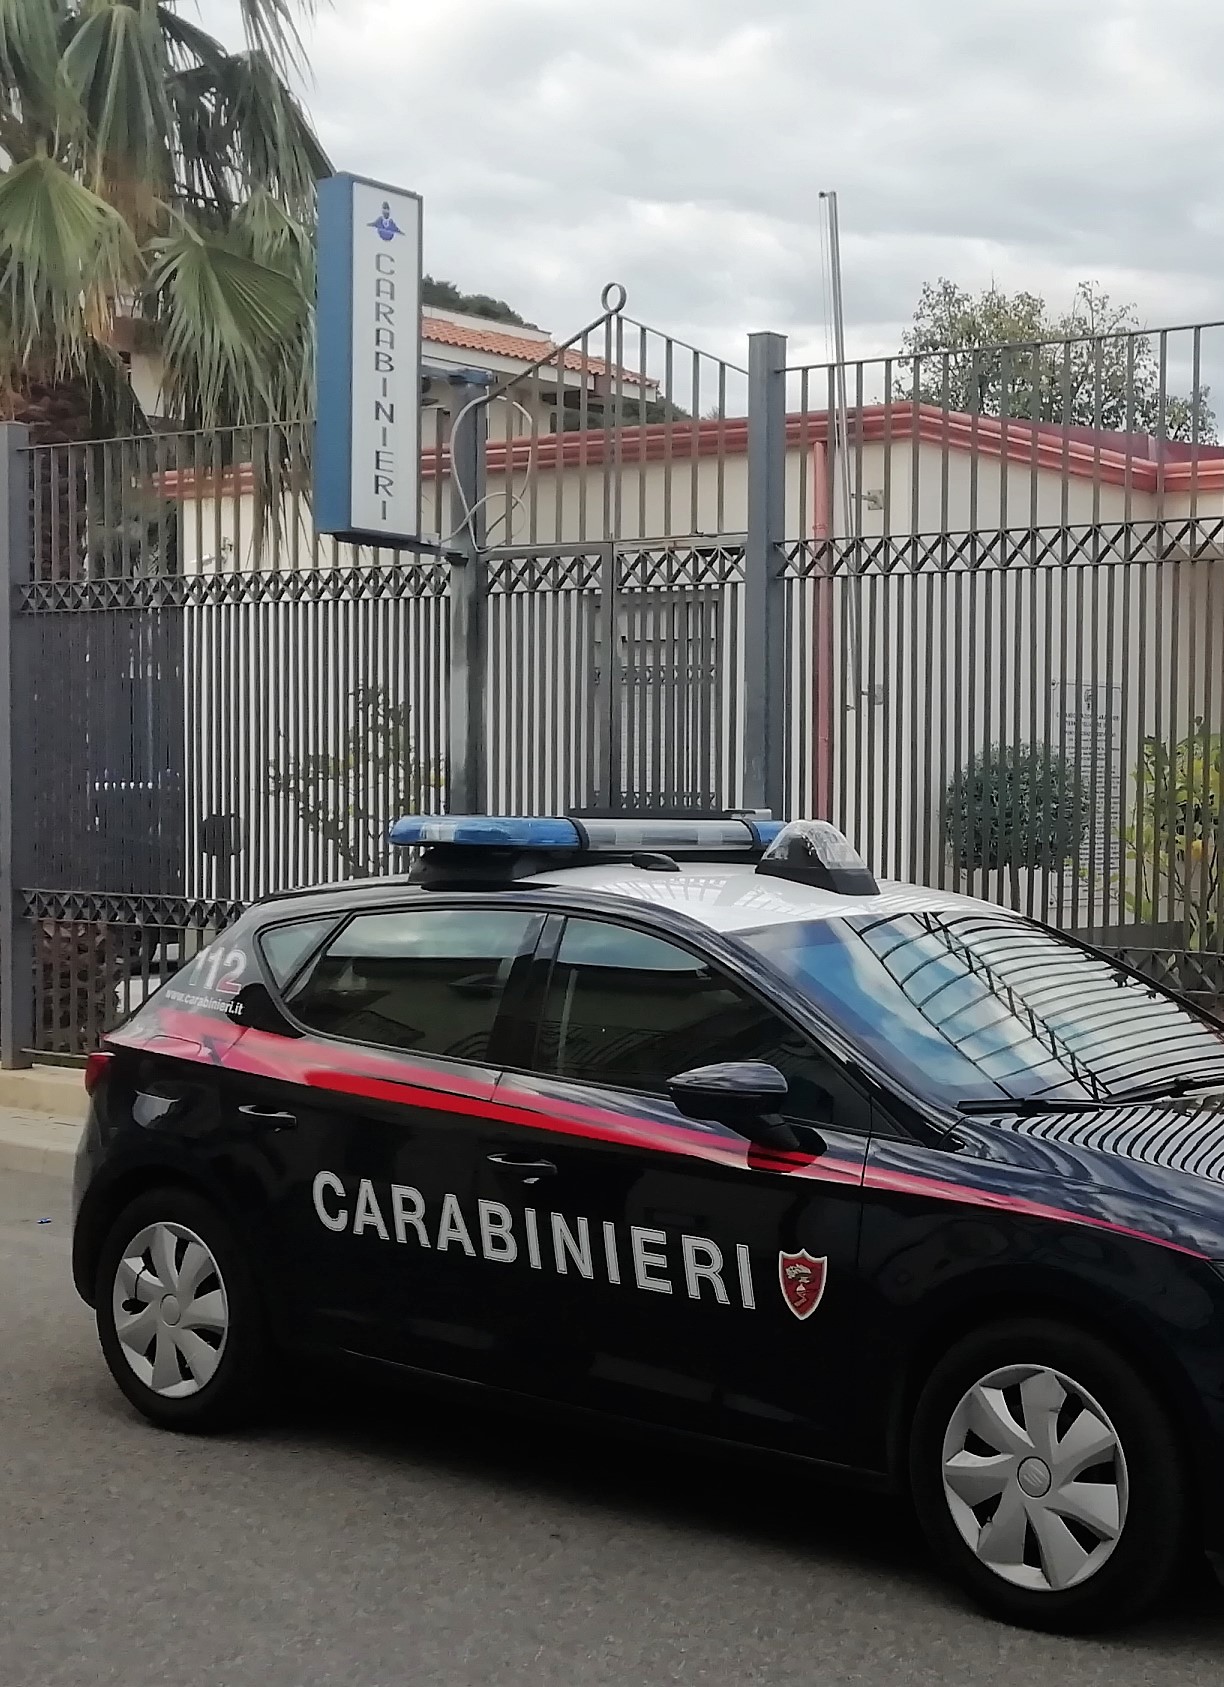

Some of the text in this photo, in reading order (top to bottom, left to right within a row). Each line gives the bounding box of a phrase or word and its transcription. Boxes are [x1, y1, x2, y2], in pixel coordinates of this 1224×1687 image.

[373, 253, 396, 520] CARABINIERI
[165, 989, 243, 1015] www.carabinieri.it
[189, 945, 247, 995] 112
[312, 1170, 756, 1310] CARABINIERI
